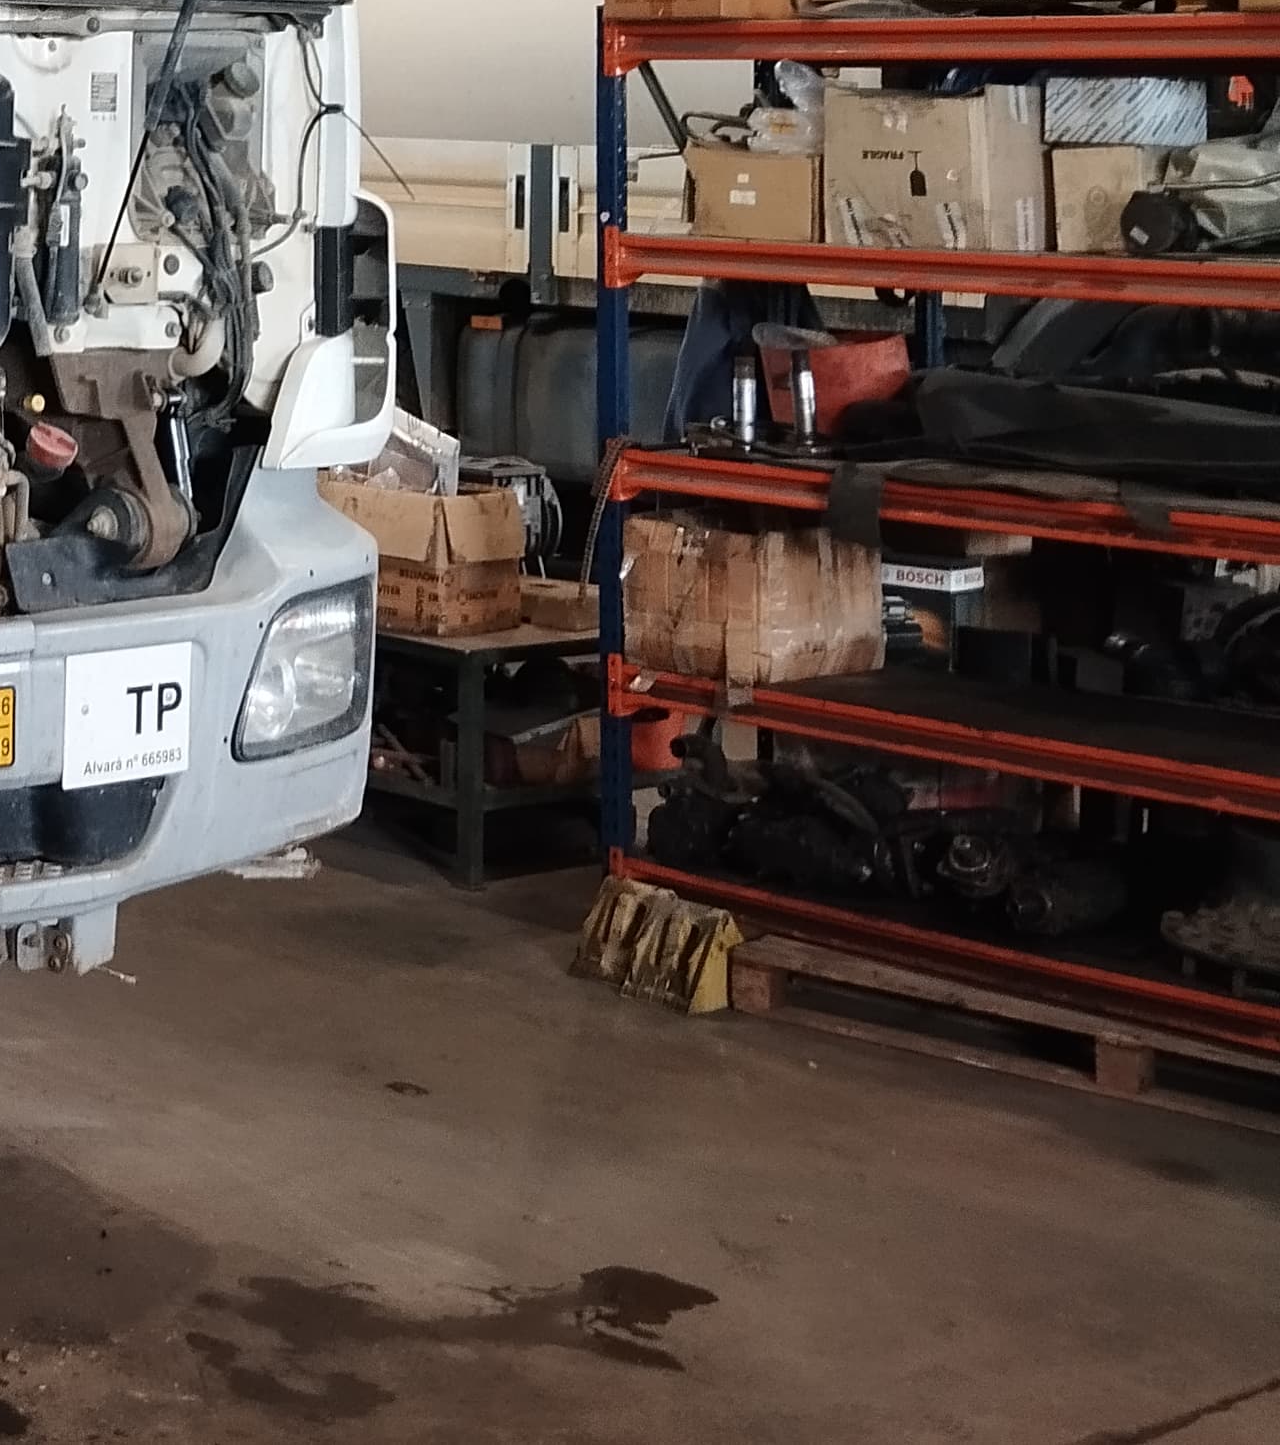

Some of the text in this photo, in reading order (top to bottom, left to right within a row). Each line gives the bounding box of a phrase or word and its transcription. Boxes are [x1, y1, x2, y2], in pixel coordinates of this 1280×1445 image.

[861, 149, 904, 161] FRAGILE
[896, 569, 945, 586] BOSCH
[126, 681, 183, 735] TP
[83, 757, 123, 776] Alvará
[142, 747, 183, 767] 665983
